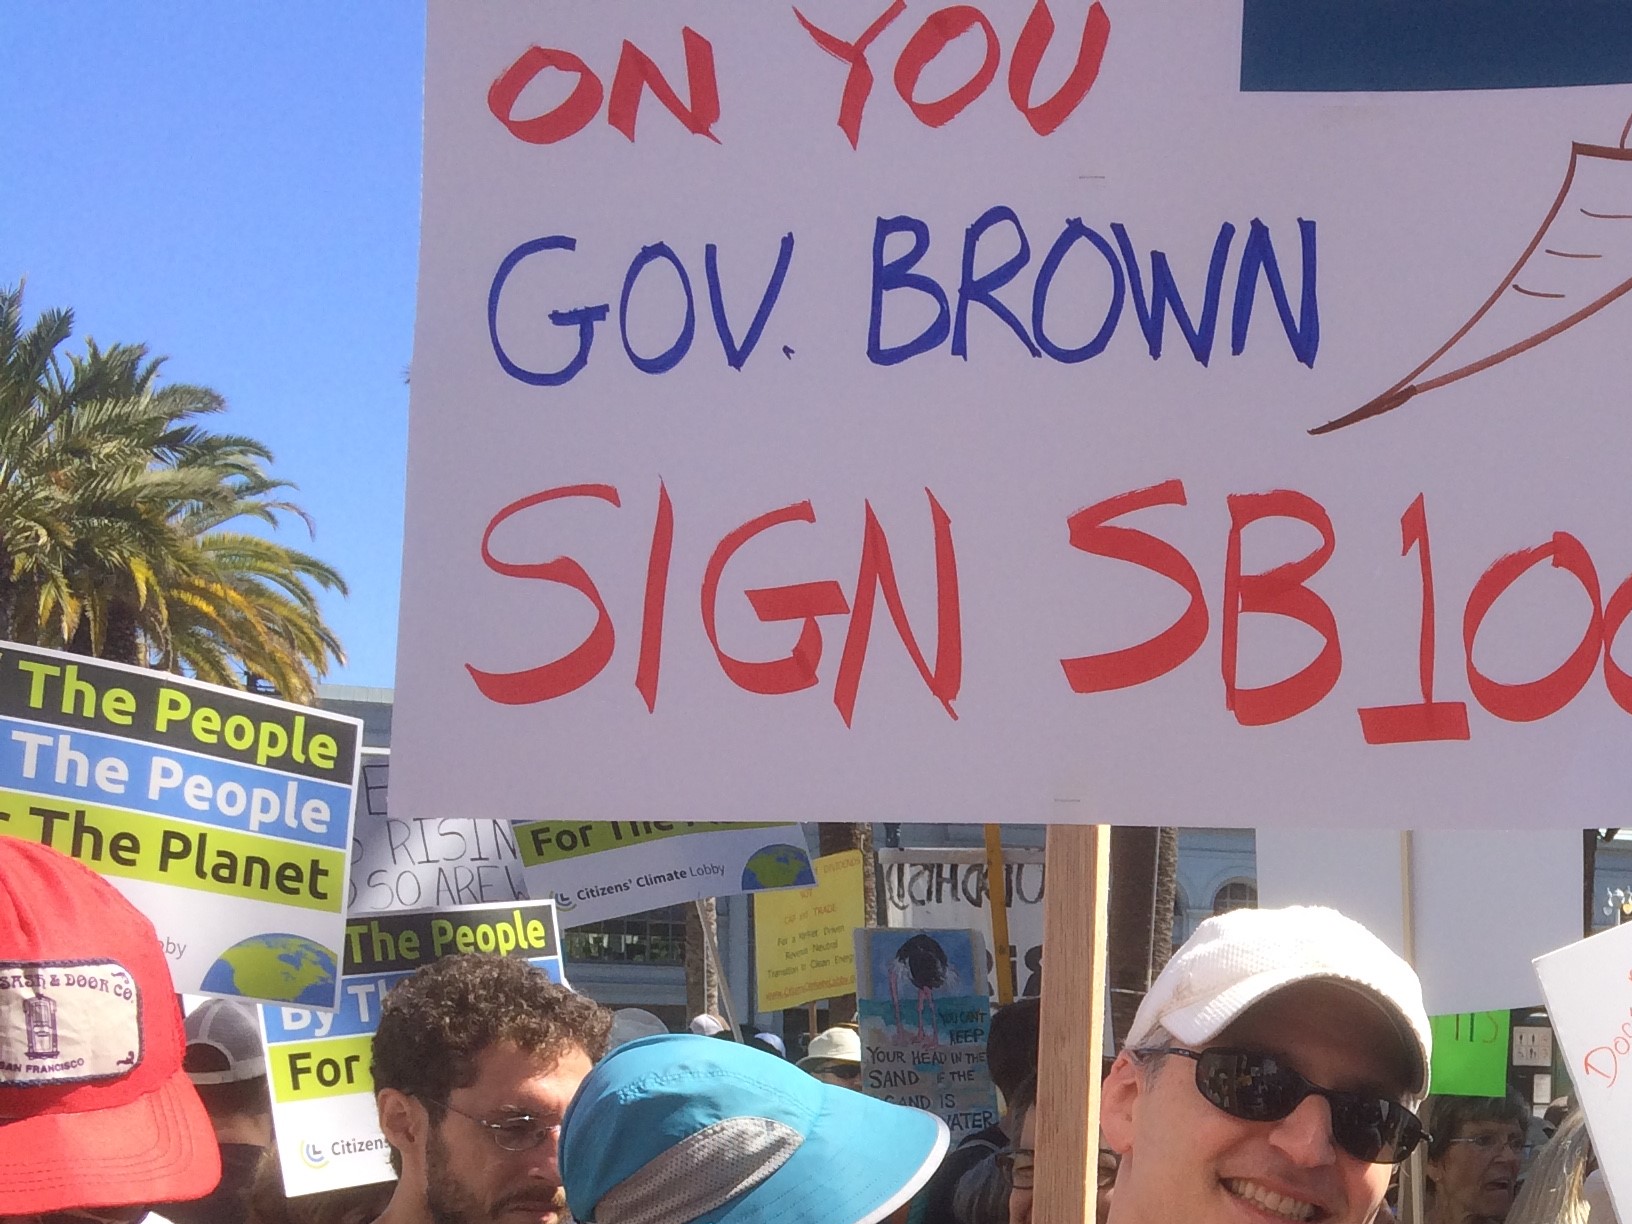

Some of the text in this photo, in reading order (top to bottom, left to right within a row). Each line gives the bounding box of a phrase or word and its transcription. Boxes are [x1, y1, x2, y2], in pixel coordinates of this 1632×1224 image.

[486, 0, 1111, 150] ON YOU
[488, 204, 1319, 386] GOV. BROWN
[464, 473, 962, 730] SIGN
[18, 660, 338, 769] The People
[11, 730, 129, 794] The
[148, 756, 331, 833] People
[29, 806, 141, 867] The
[158, 830, 330, 900] Planet
[386, 818, 517, 865] RISIN
[530, 824, 593, 856] For
[367, 869, 421, 909] SO
[576, 879, 632, 901] Citizens'
[636, 869, 687, 888] Climate
[689, 863, 725, 878] Lobby
[345, 910, 545, 964] The People
[64, 974, 109, 993] DOOR
[866, 1047, 987, 1065] YOUR HEAD IN THE
[950, 1028, 984, 1045] KEEP
[25, 1057, 85, 1073] FRANCISCO
[288, 1052, 360, 1090] For
[869, 1070, 919, 1088] SAND
[950, 1070, 975, 1082] THE
[940, 1093, 955, 1108] IS
